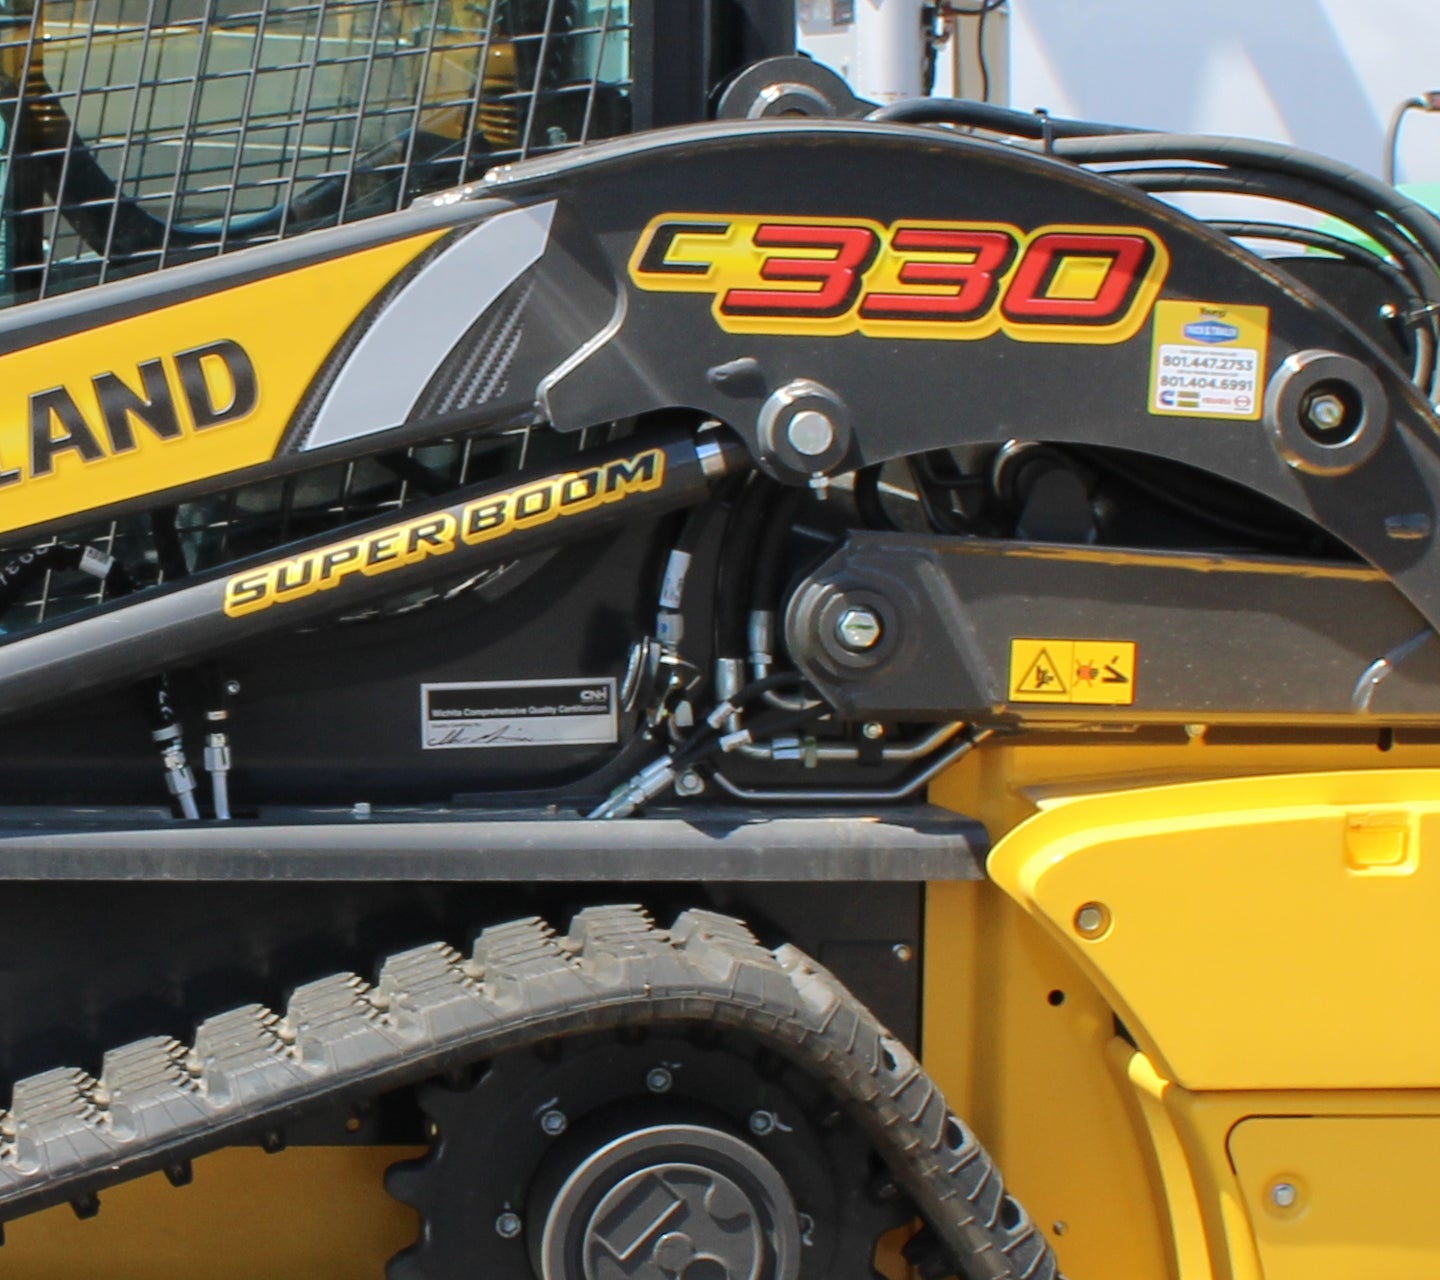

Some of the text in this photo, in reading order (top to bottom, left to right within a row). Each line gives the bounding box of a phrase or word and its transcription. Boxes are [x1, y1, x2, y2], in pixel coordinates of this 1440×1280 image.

[633, 218, 1158, 326] C330
[1162, 355, 1253, 371] 801.447.2753
[1160, 375, 1252, 391] 801.404.6991
[228, 450, 660, 608] SUPER BOOM
[431, 704, 608, 718] Wichita Comprehensive Quality Certification
